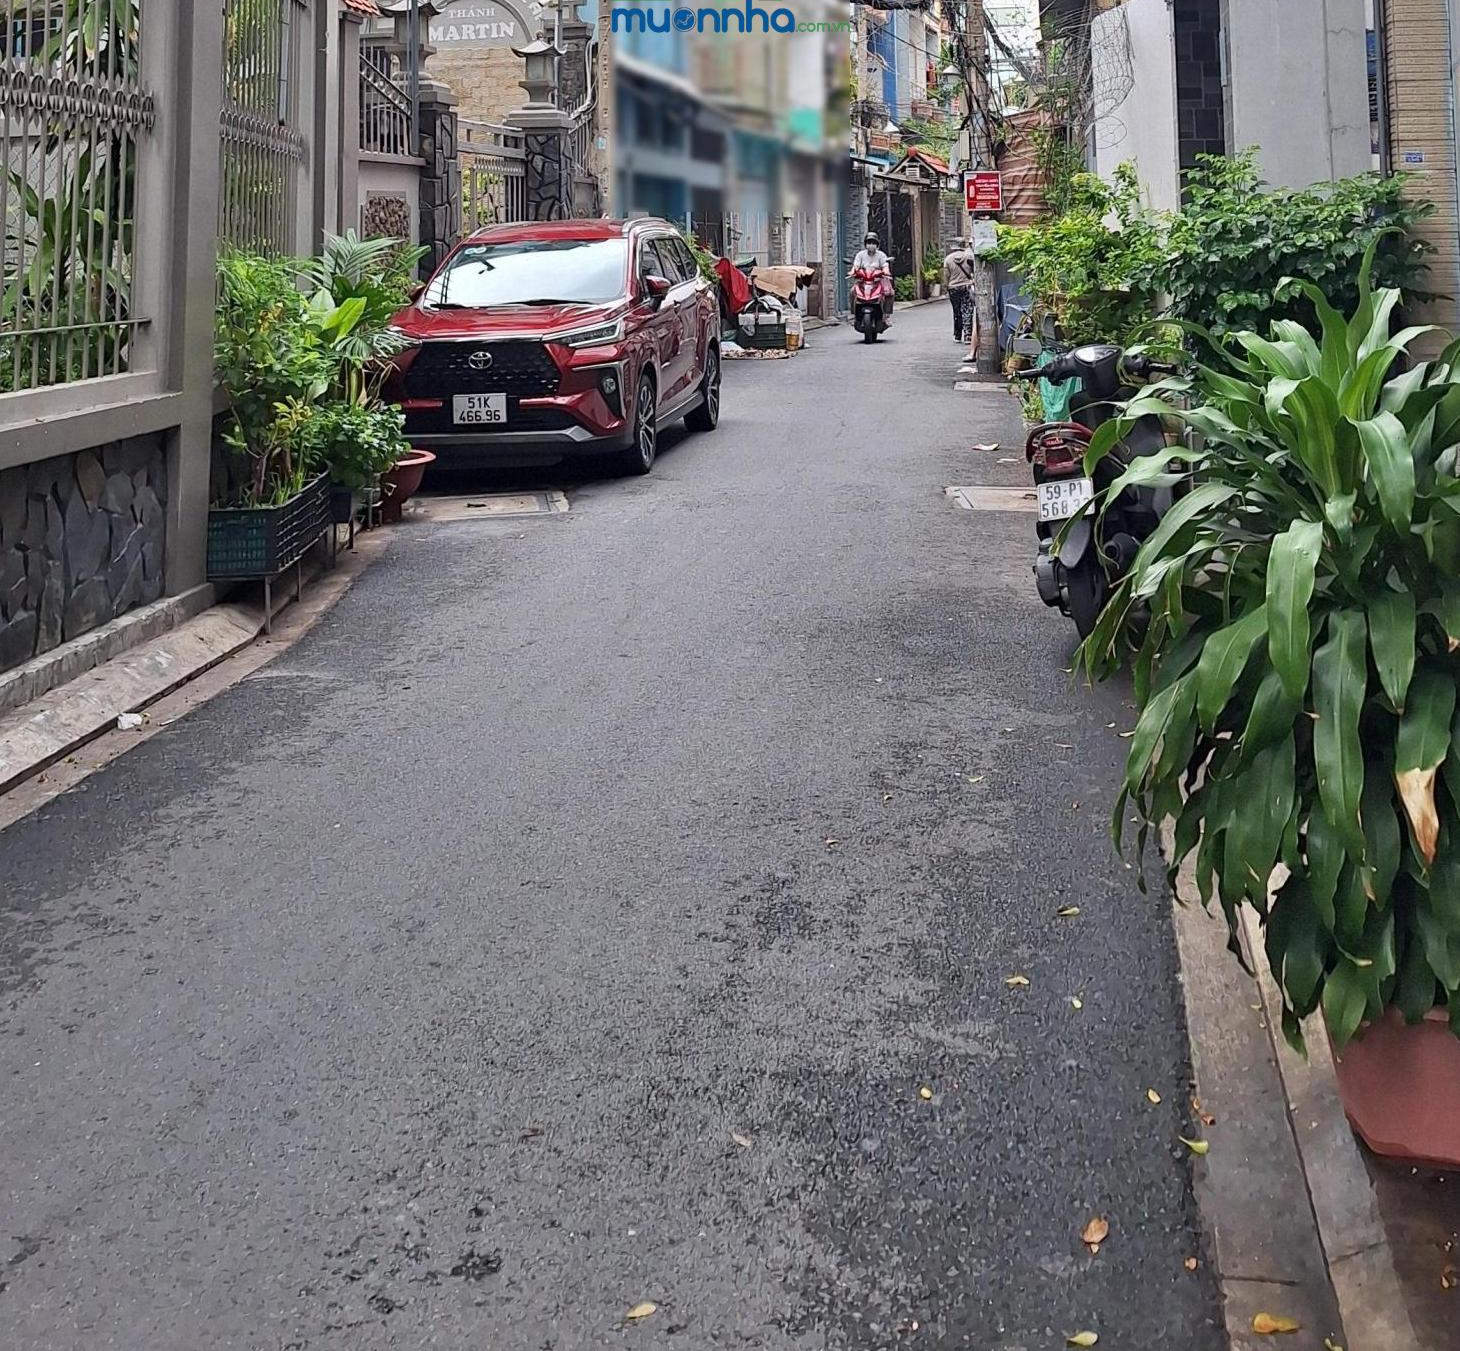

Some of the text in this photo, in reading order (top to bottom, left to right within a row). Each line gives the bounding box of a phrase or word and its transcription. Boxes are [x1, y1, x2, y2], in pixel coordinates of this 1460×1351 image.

[447, 5, 496, 18] THÁNH
[429, 22, 515, 41] MARTIN
[467, 396, 491, 409] 51K
[459, 409, 501, 423] 466.96
